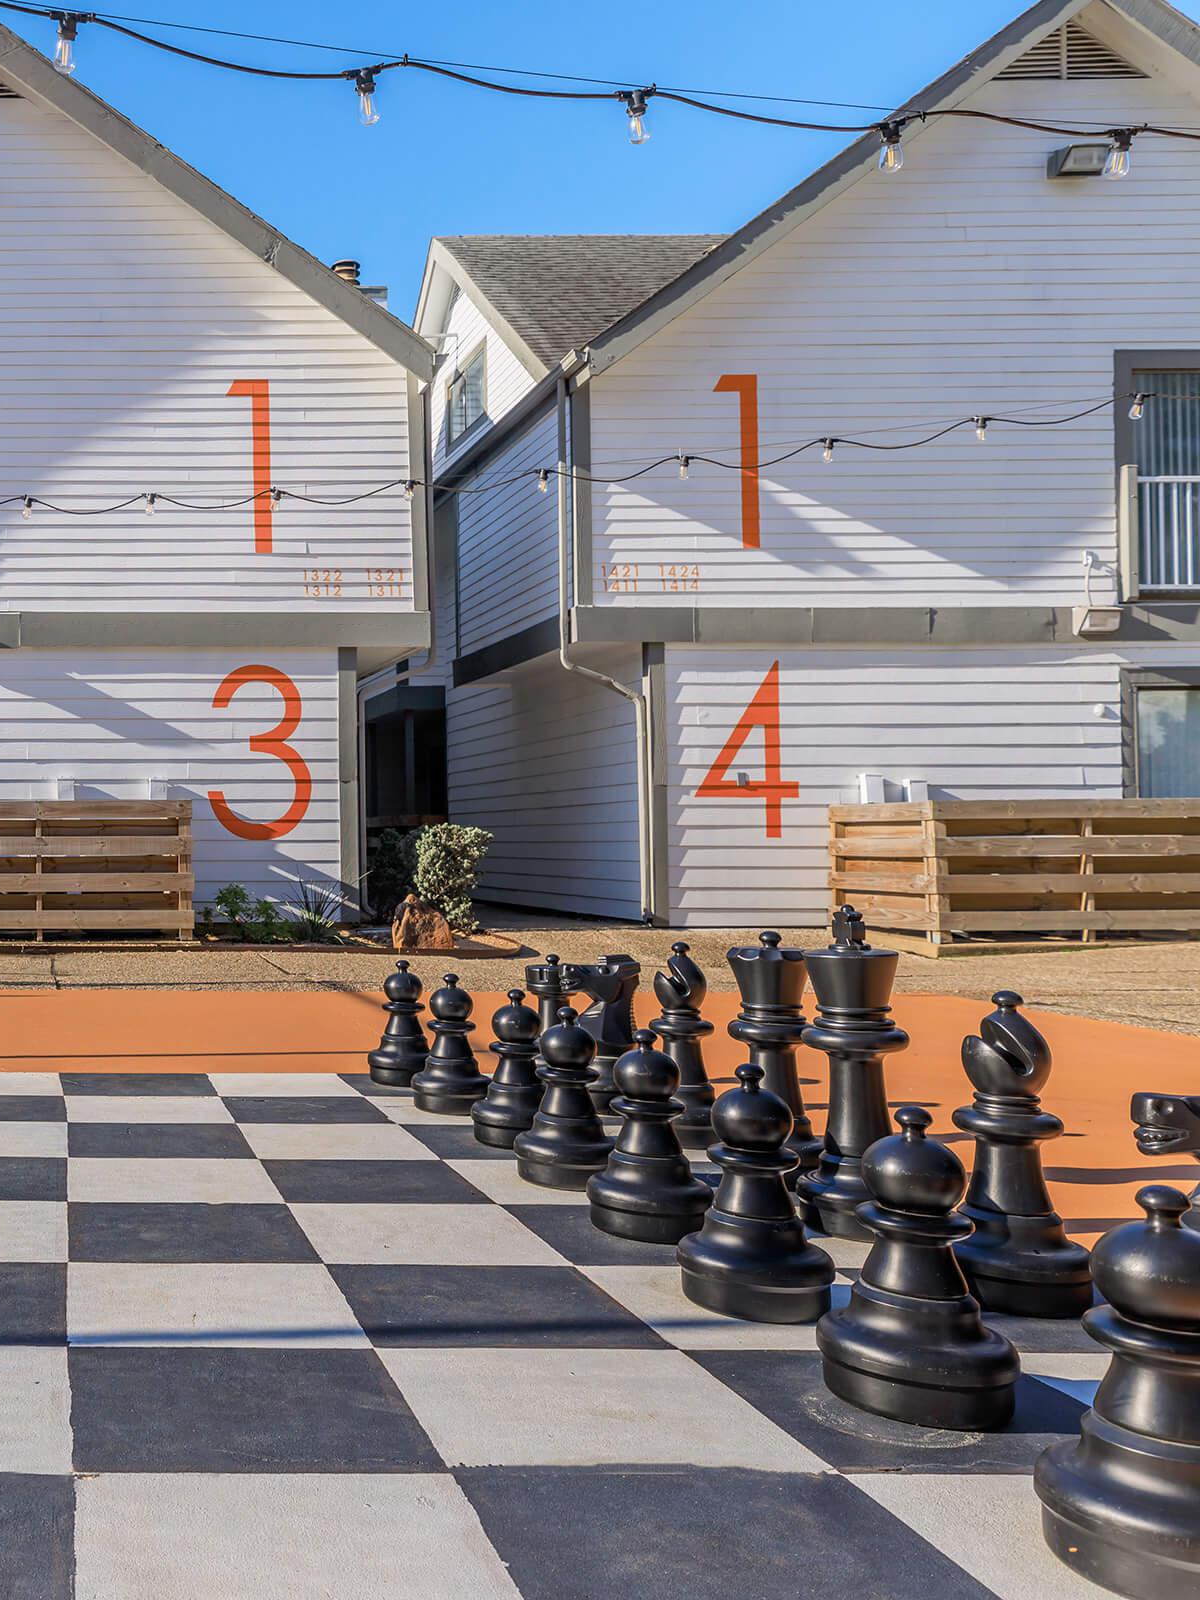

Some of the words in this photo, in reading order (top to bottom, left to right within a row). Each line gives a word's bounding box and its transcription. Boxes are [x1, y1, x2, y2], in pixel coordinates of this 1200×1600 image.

[303, 568, 342, 582] 1322
[367, 568, 404, 582] 1321
[601, 564, 638, 577] 1421
[659, 564, 700, 577] 1424
[304, 584, 342, 597] 1312
[368, 584, 403, 597] 1311
[603, 579, 638, 592] 1411
[661, 579, 700, 592] 1414
[207, 664, 313, 841] 3
[694, 661, 801, 839] 4
